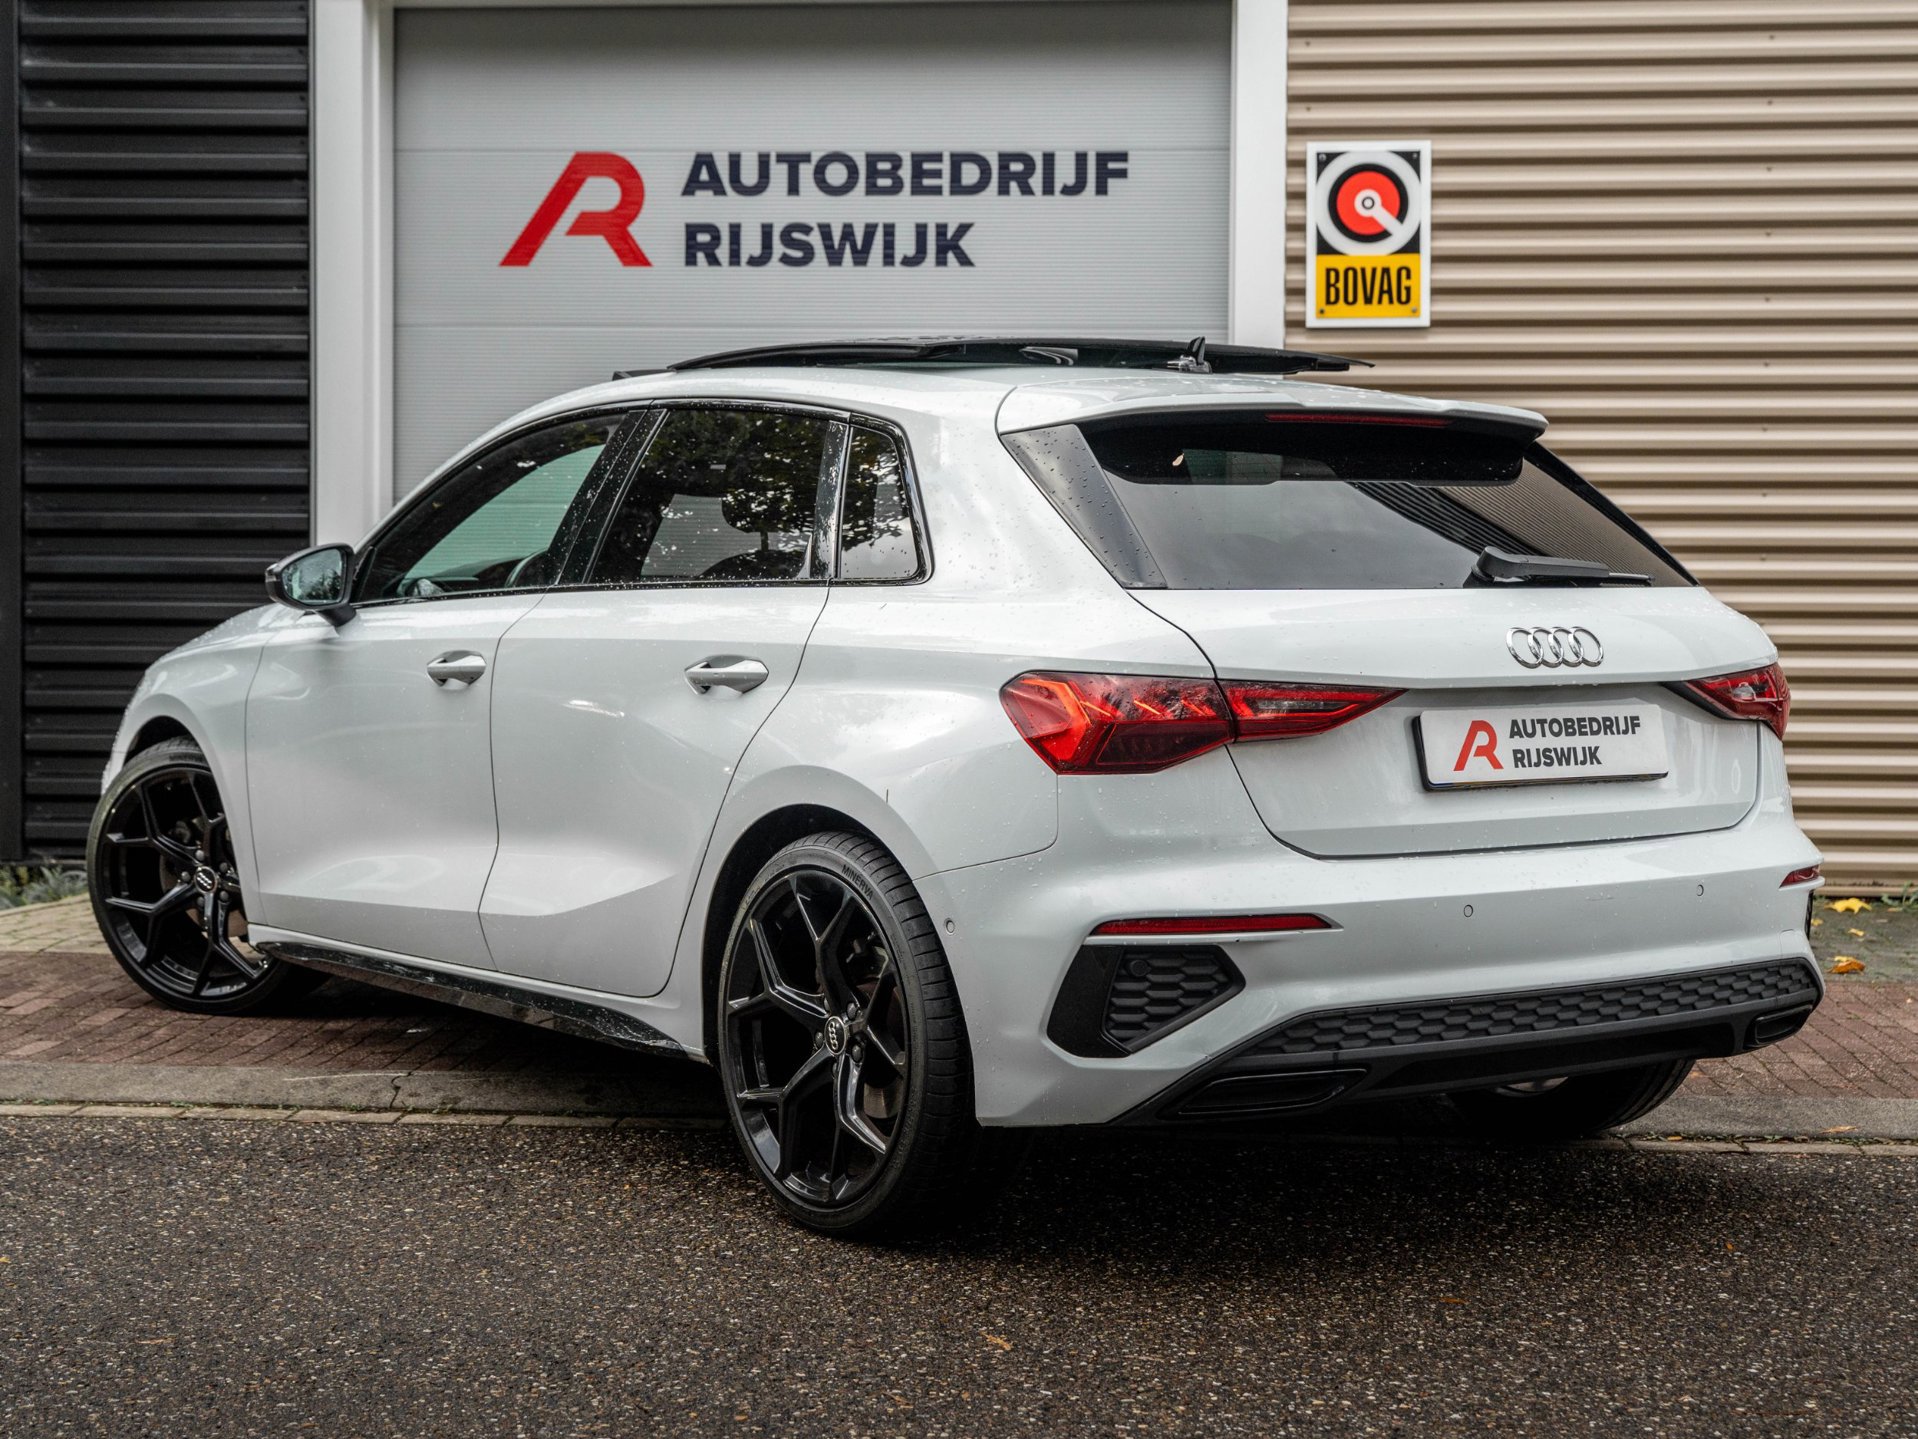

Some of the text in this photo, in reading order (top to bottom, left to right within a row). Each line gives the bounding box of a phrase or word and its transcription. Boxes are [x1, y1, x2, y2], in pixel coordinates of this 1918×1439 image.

[681, 150, 1129, 197] AUTOBEDRIJF
[684, 222, 975, 268] RIJSWIJK
[1325, 266, 1412, 306] BOVAG
[1509, 715, 1641, 739] AUTOBEDRIJF
[1512, 745, 1603, 769] RIJSWIJK
[841, 864, 874, 901] MINERVA
